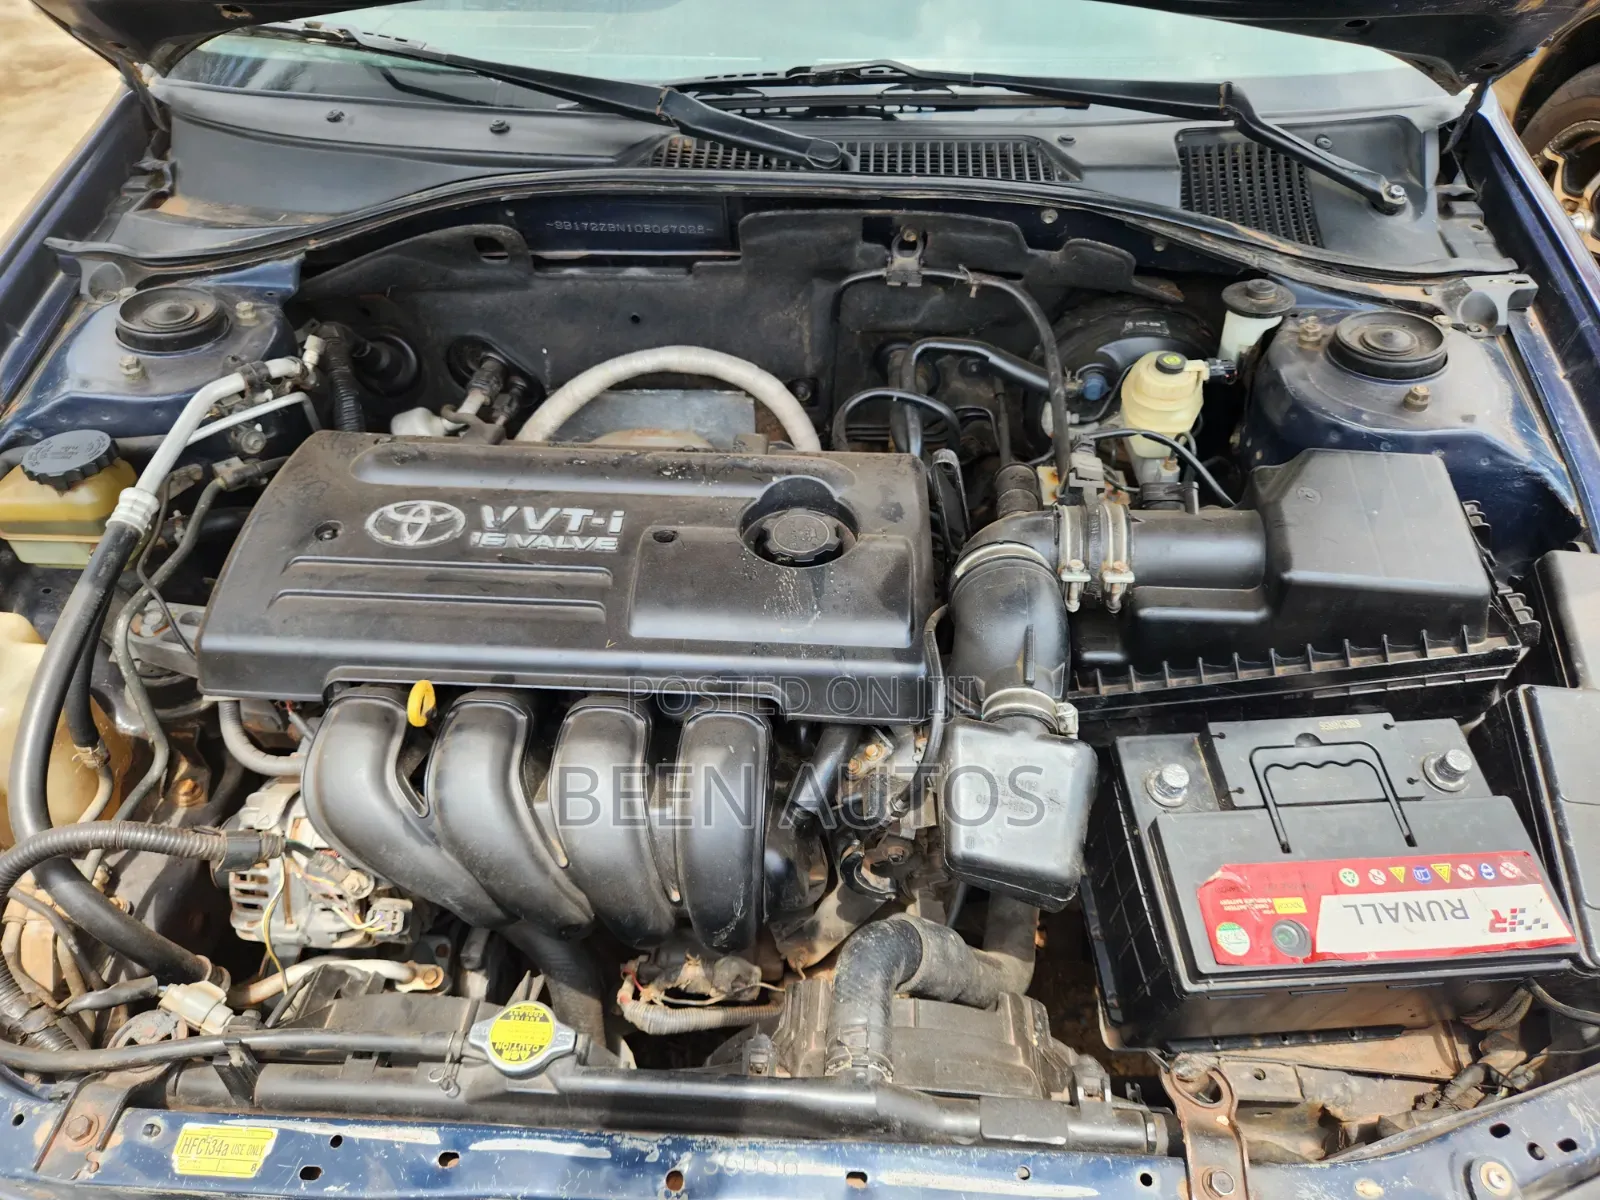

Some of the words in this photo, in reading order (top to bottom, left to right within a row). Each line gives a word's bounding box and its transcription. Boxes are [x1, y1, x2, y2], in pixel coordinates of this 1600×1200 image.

[513, 533, 618, 551] VALVE
[1342, 898, 1470, 926] RUNALL
[181, 1136, 230, 1157] HFC134a
[230, 1143, 246, 1156] USE
[246, 1144, 266, 1157] ONLY
